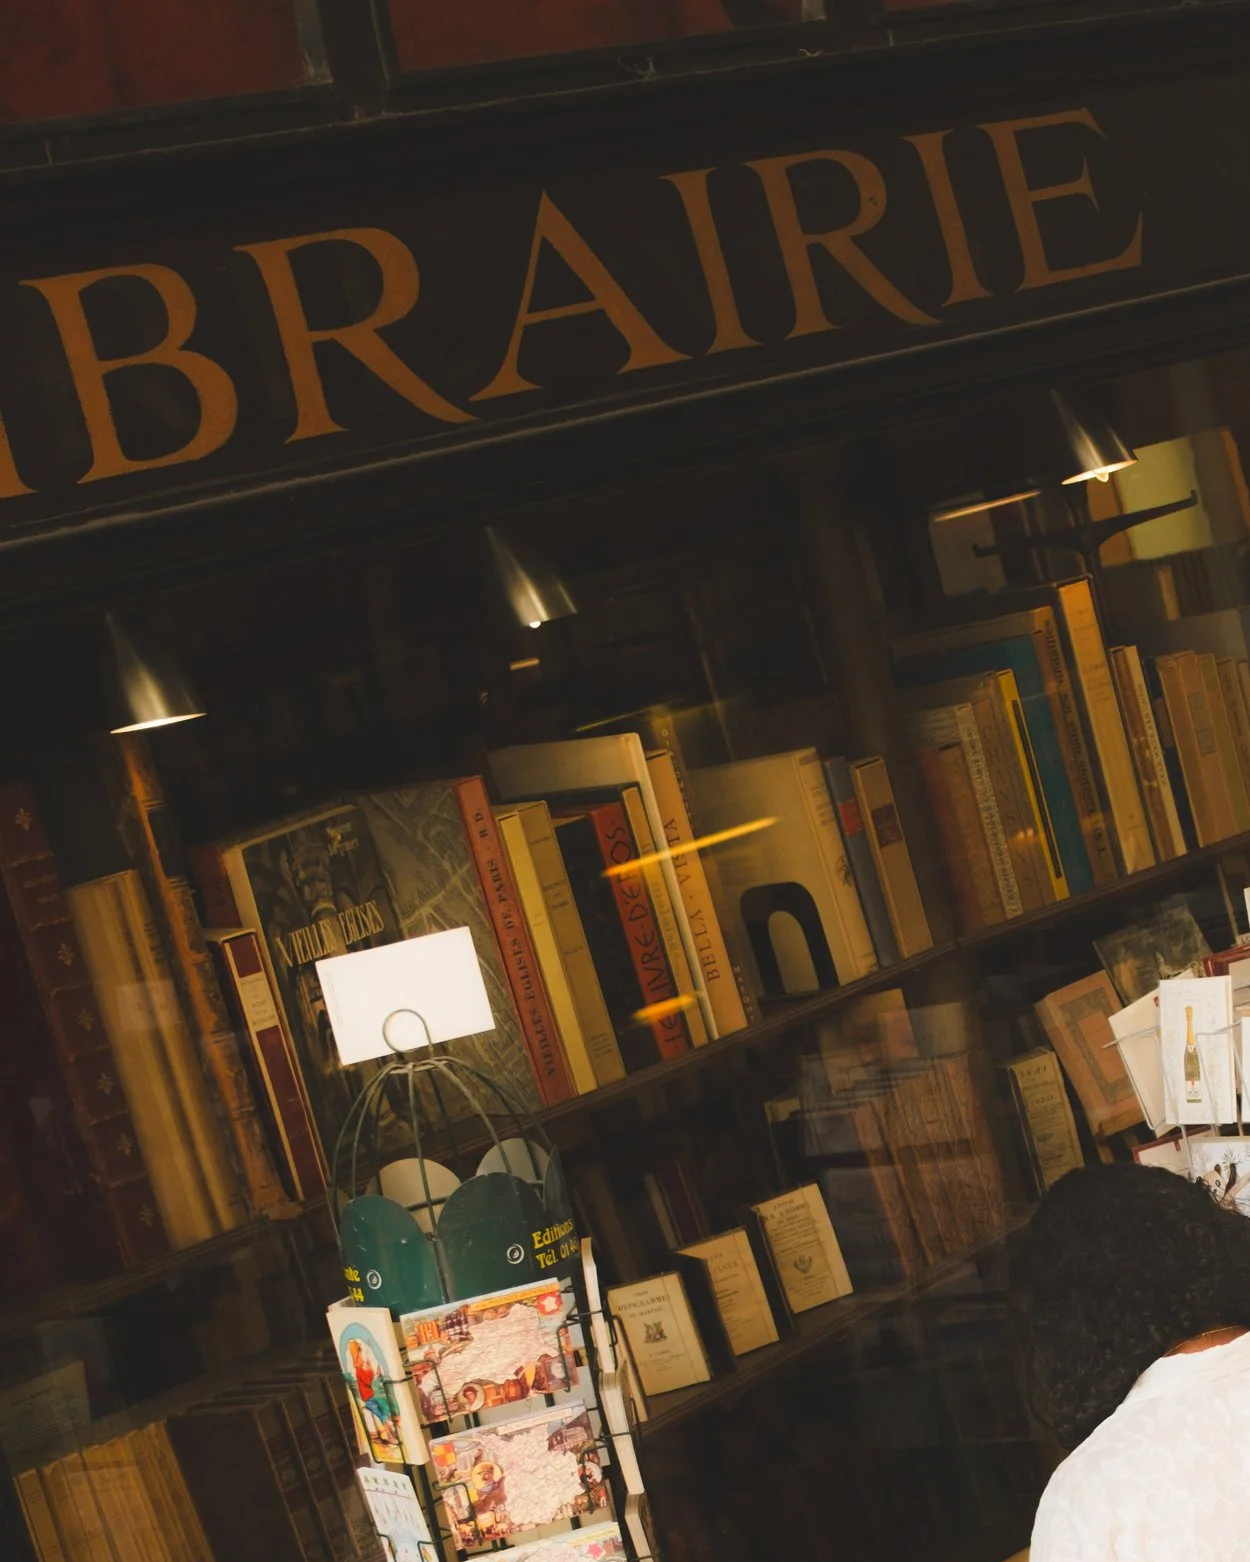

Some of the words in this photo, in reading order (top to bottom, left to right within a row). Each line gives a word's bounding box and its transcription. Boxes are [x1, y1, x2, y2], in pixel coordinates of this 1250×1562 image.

[486, 856, 508, 903] PARIS
[661, 817, 693, 884] VISTA
[687, 908, 722, 982] BELLA
[528, 1006, 557, 1076] VIEILLES
[531, 1218, 575, 1250] Editions
